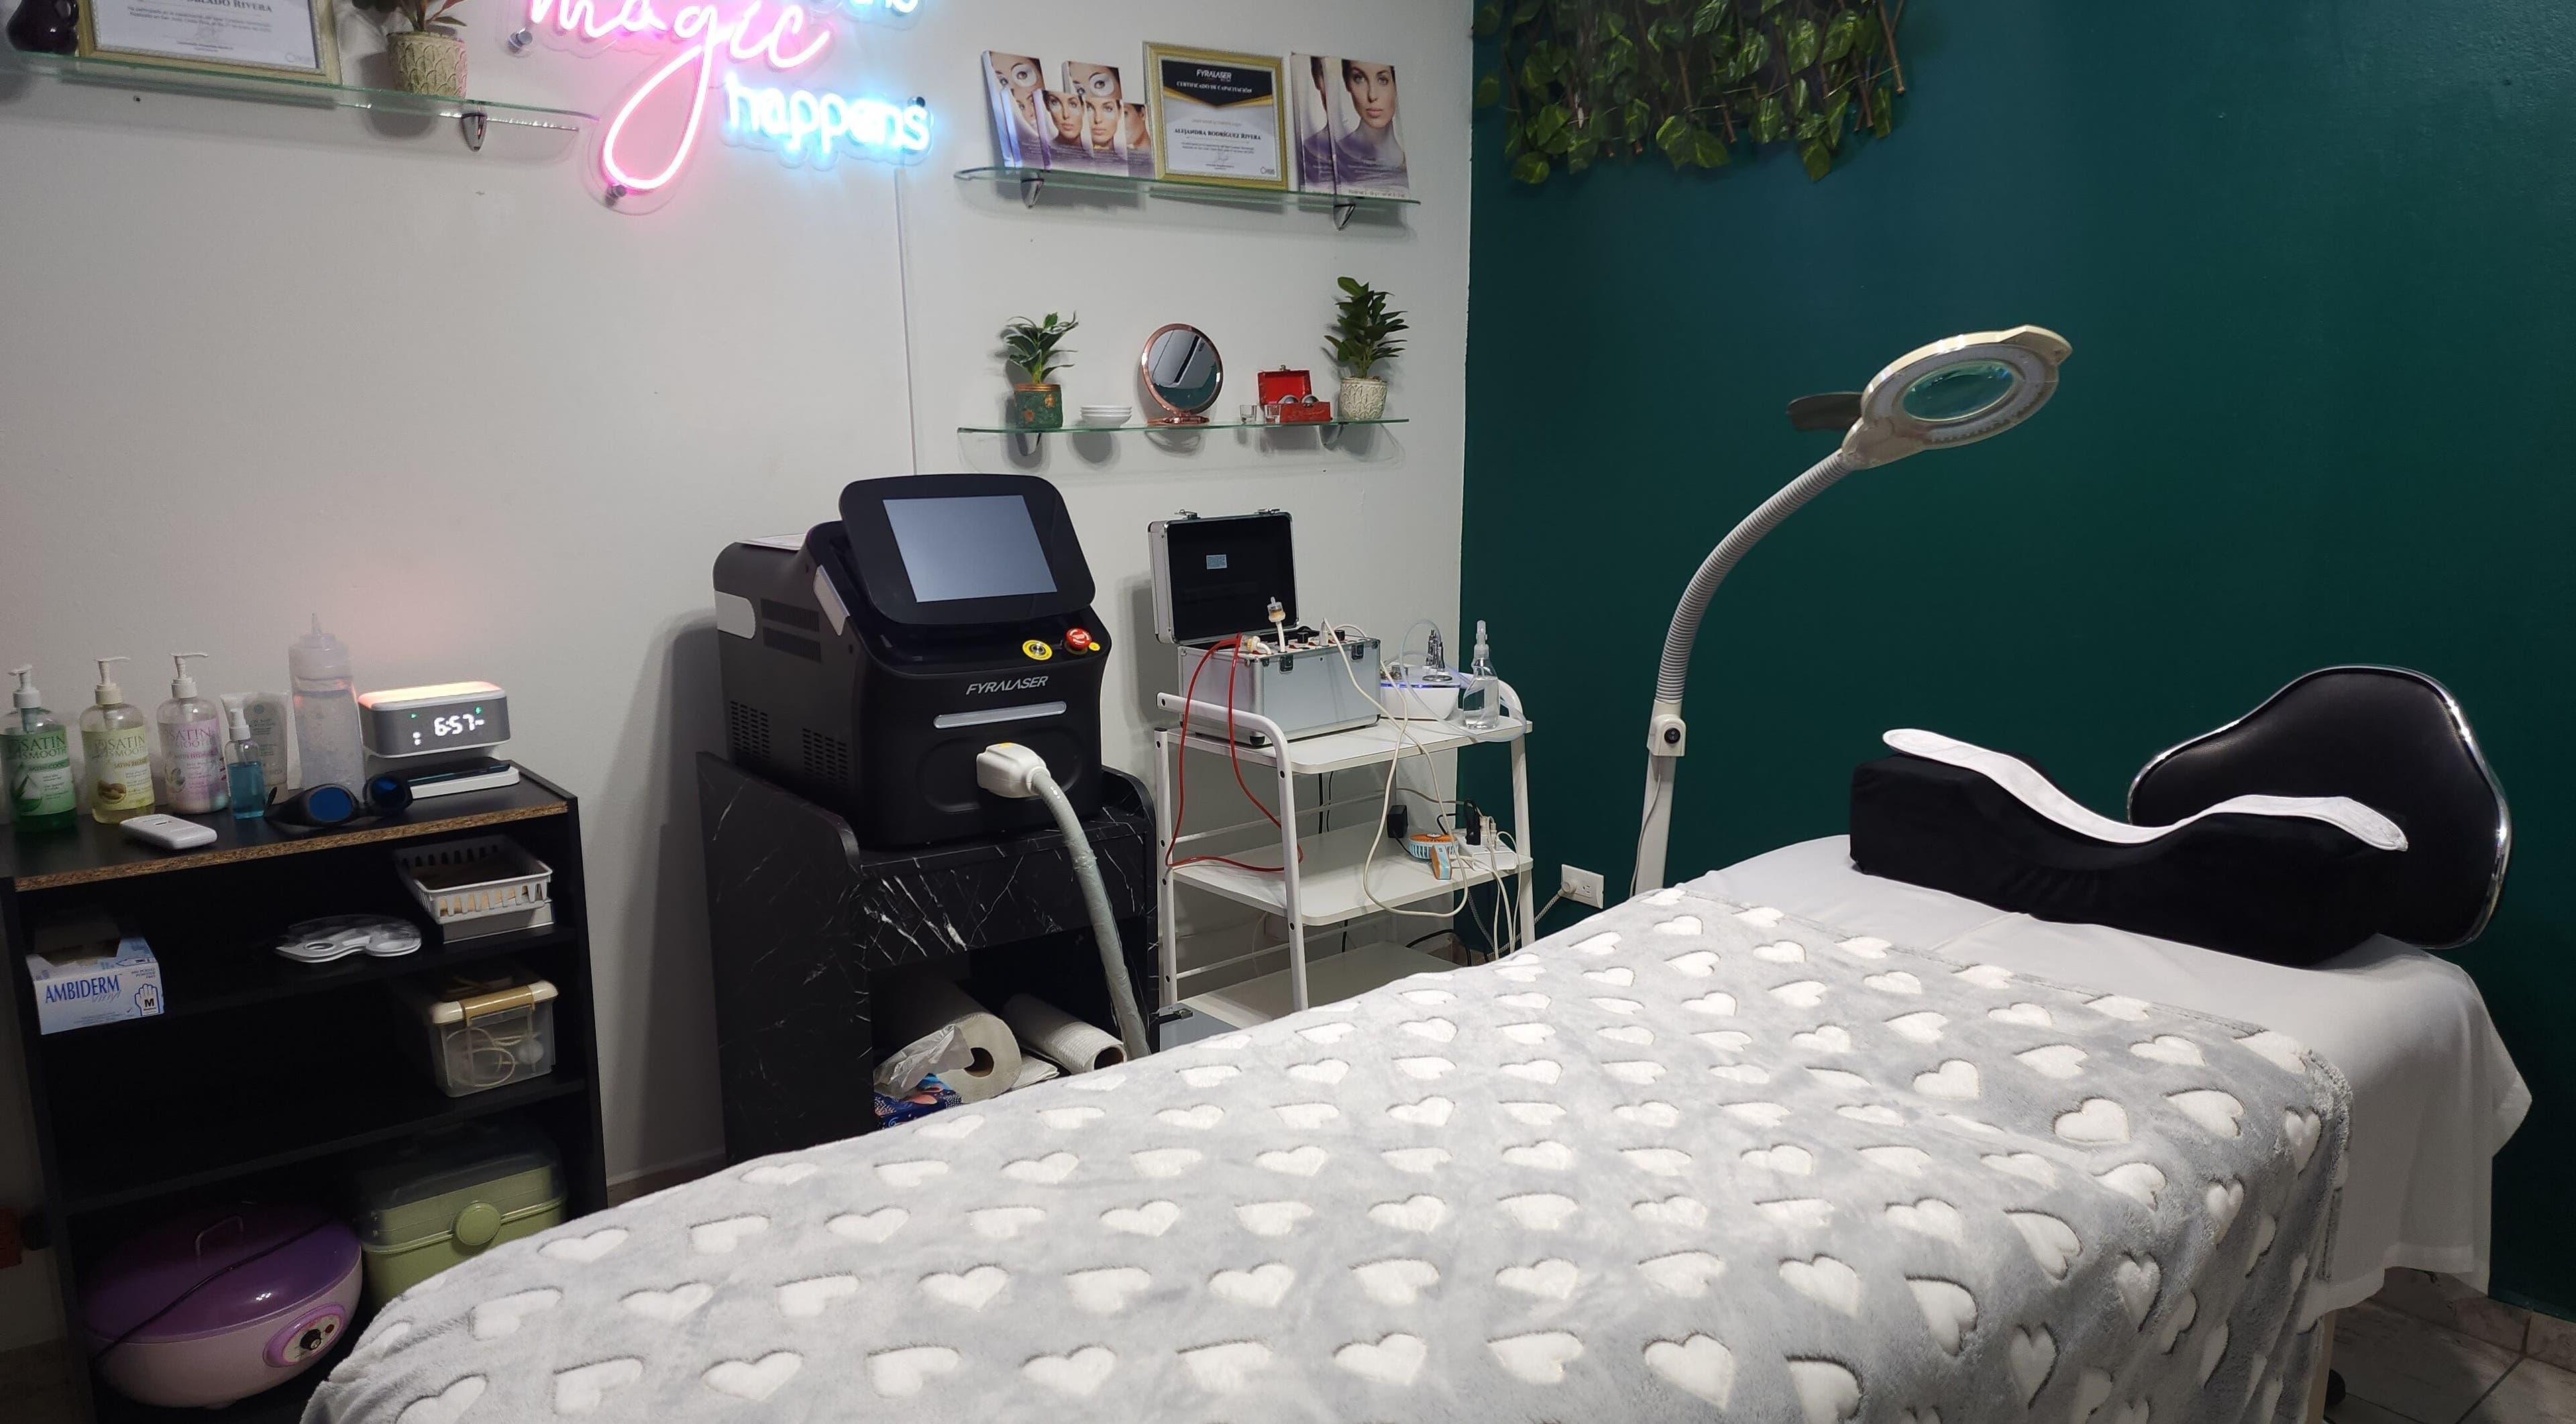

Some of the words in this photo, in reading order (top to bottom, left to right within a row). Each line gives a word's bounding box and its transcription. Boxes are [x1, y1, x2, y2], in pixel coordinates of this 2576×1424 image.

[1196, 68, 1232, 79] FYRALASER
[530, 0, 830, 189] magic
[724, 72, 930, 155] happens
[1175, 128, 1207, 136] ALEJANDRA
[1241, 132, 1261, 140] RIVERA
[966, 675, 1049, 696] FYRALASER
[434, 714, 475, 736] 6:57
[21, 735, 66, 752] SATIN
[107, 734, 145, 751] SATIN
[45, 975, 119, 1004] AMBIDERM
[144, 998, 154, 1007] M
